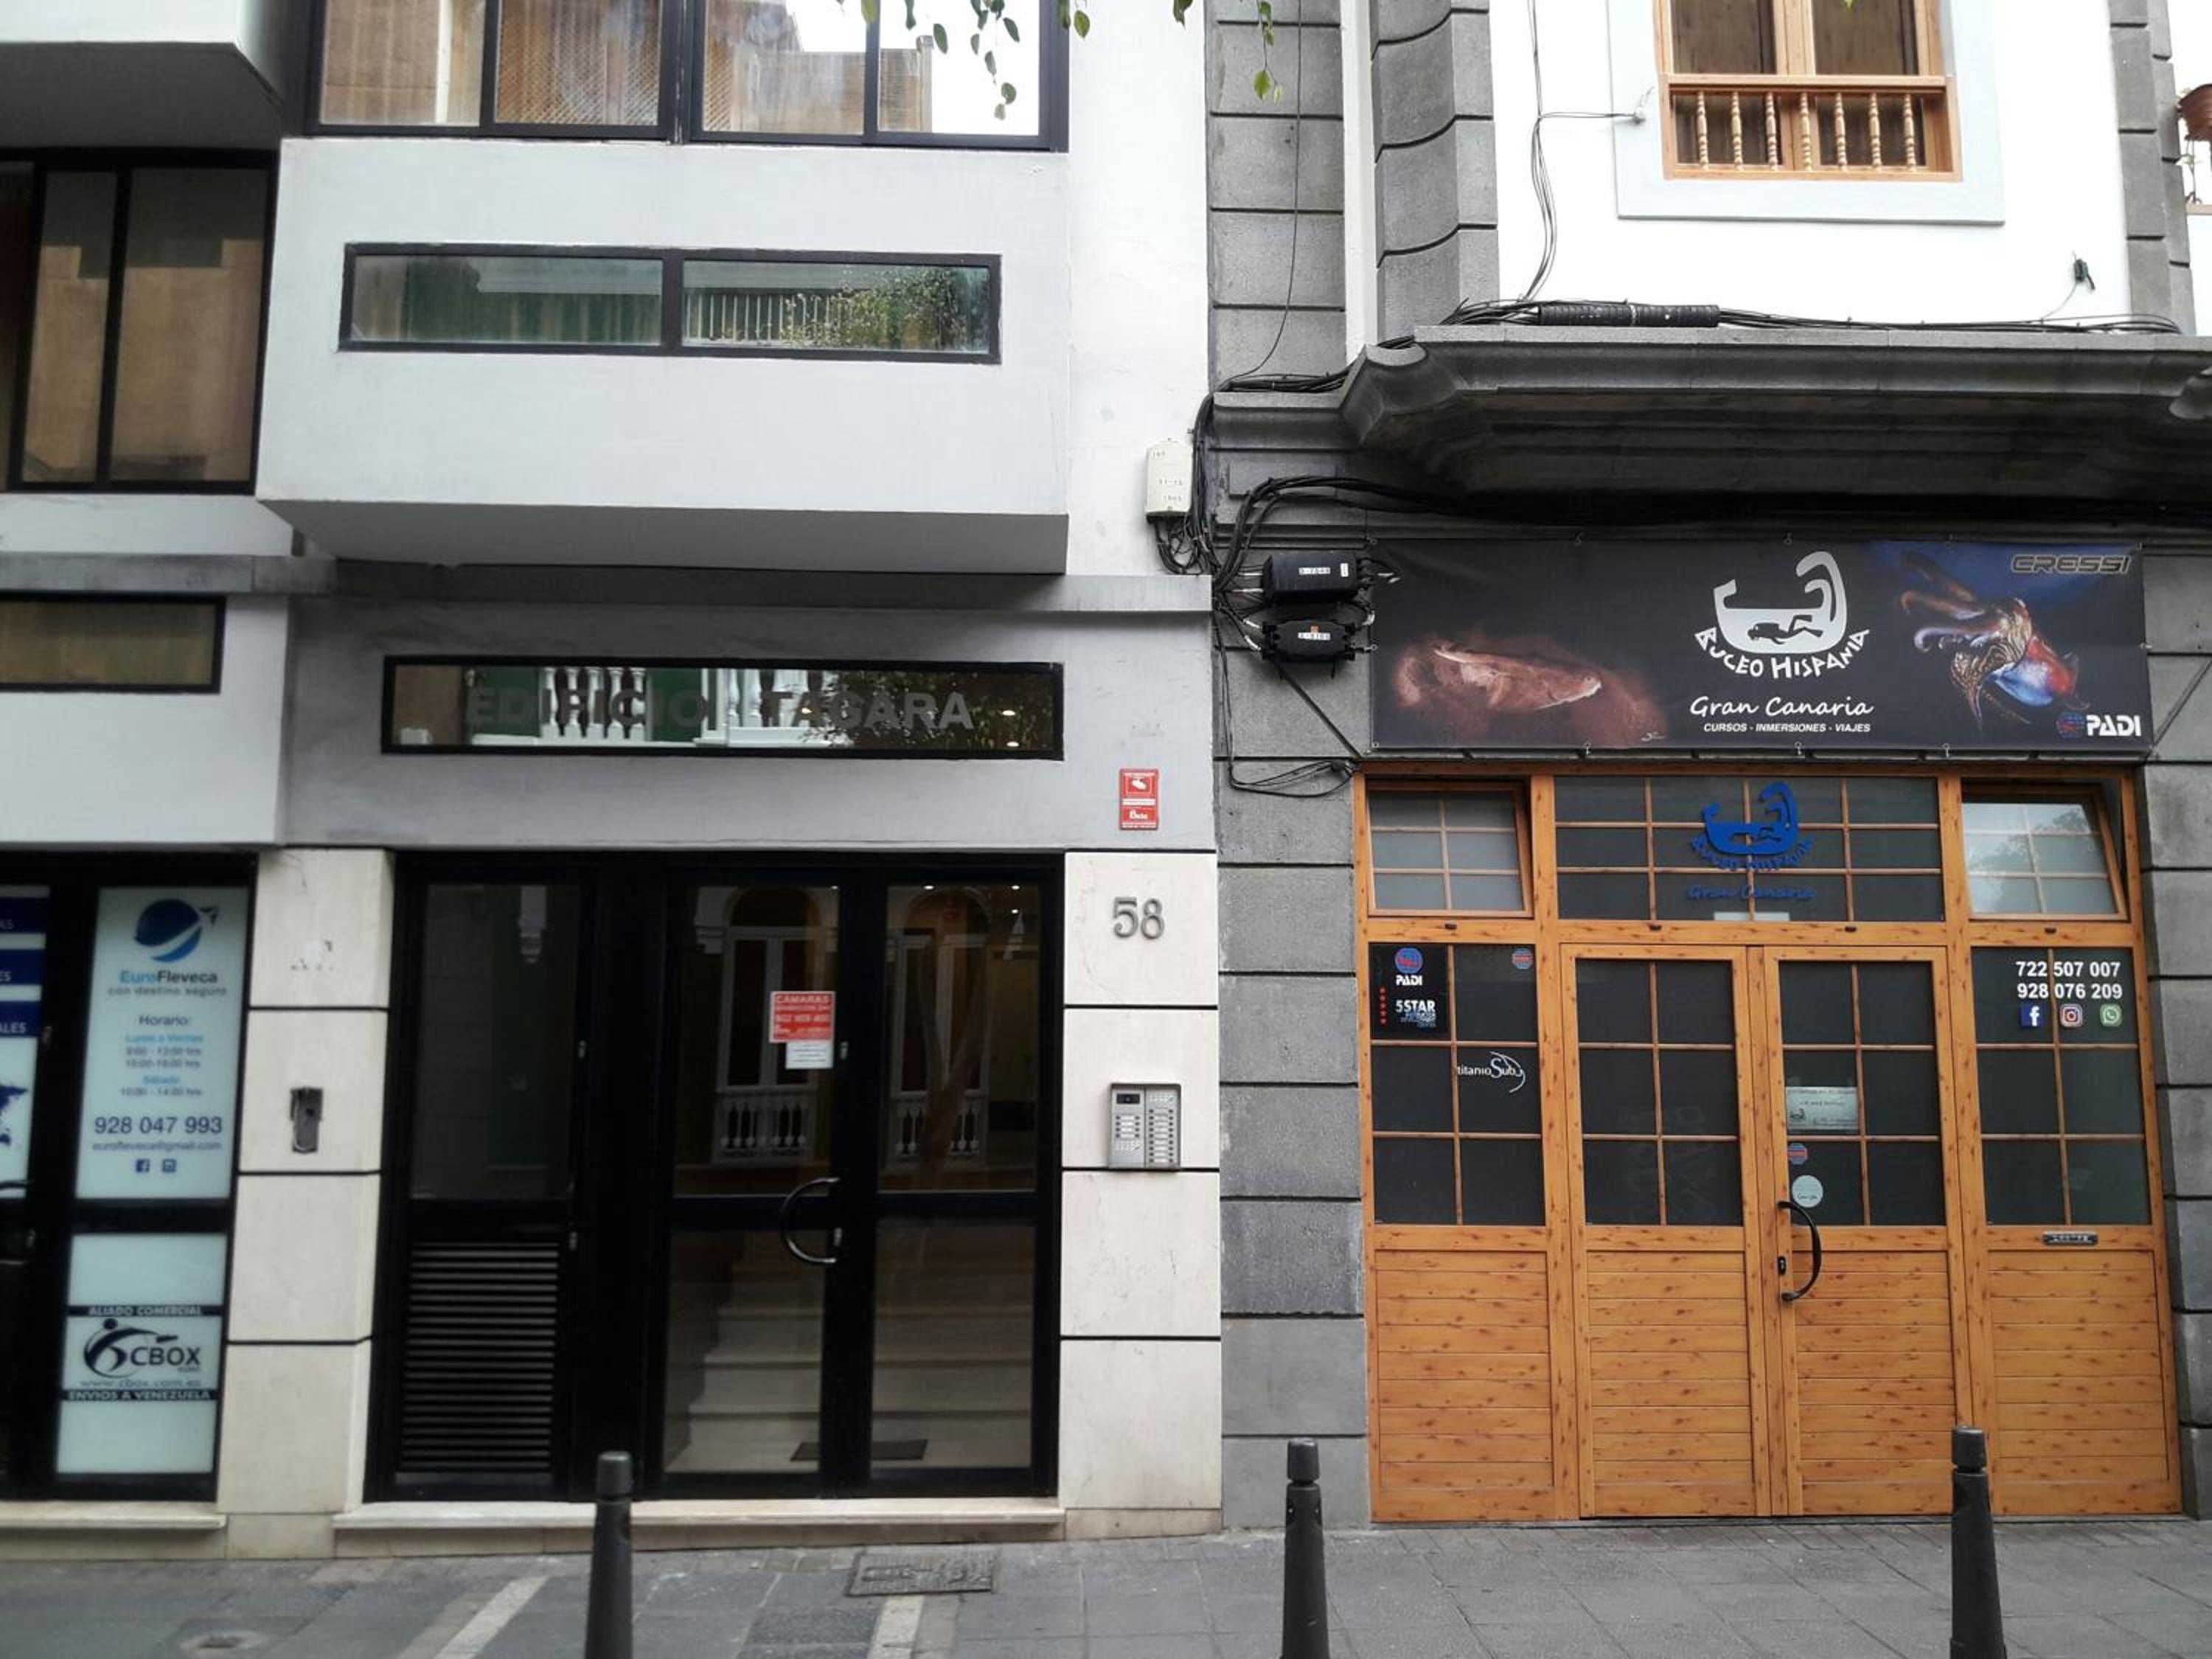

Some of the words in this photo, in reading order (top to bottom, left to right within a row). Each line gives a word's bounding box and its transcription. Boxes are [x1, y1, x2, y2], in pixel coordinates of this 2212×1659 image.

[2011, 554, 2132, 574] CRESSI
[1770, 629, 1871, 679] HISPANIA
[467, 686, 709, 726] EDIFICIO
[761, 690, 974, 730] TAGARA
[1690, 696, 1760, 717] Gran
[1765, 695, 1875, 717] Canaria
[1703, 723, 1748, 732] CURSOS
[1756, 723, 1826, 732] INMERSIONES
[1835, 723, 1871, 732] VIAJES
[2086, 714, 2142, 737] PADI
[1113, 897, 1165, 940] 58
[119, 969, 218, 984] EuroFleveca
[2015, 961, 2048, 977] 722
[2053, 961, 2084, 977] 507
[2090, 961, 2121, 977] 007
[1396, 975, 1422, 986] PADI
[2017, 983, 2050, 999] 928
[2054, 983, 2086, 999] 076
[2091, 983, 2123, 999] 209
[94, 1116, 133, 1135] 928
[139, 1116, 178, 1135] 047
[185, 1116, 223, 1134] 993
[136, 1307, 203, 1315] COMERCIAL
[130, 1346, 201, 1366] CBOX
[133, 1391, 211, 1400] VENEZUELA
